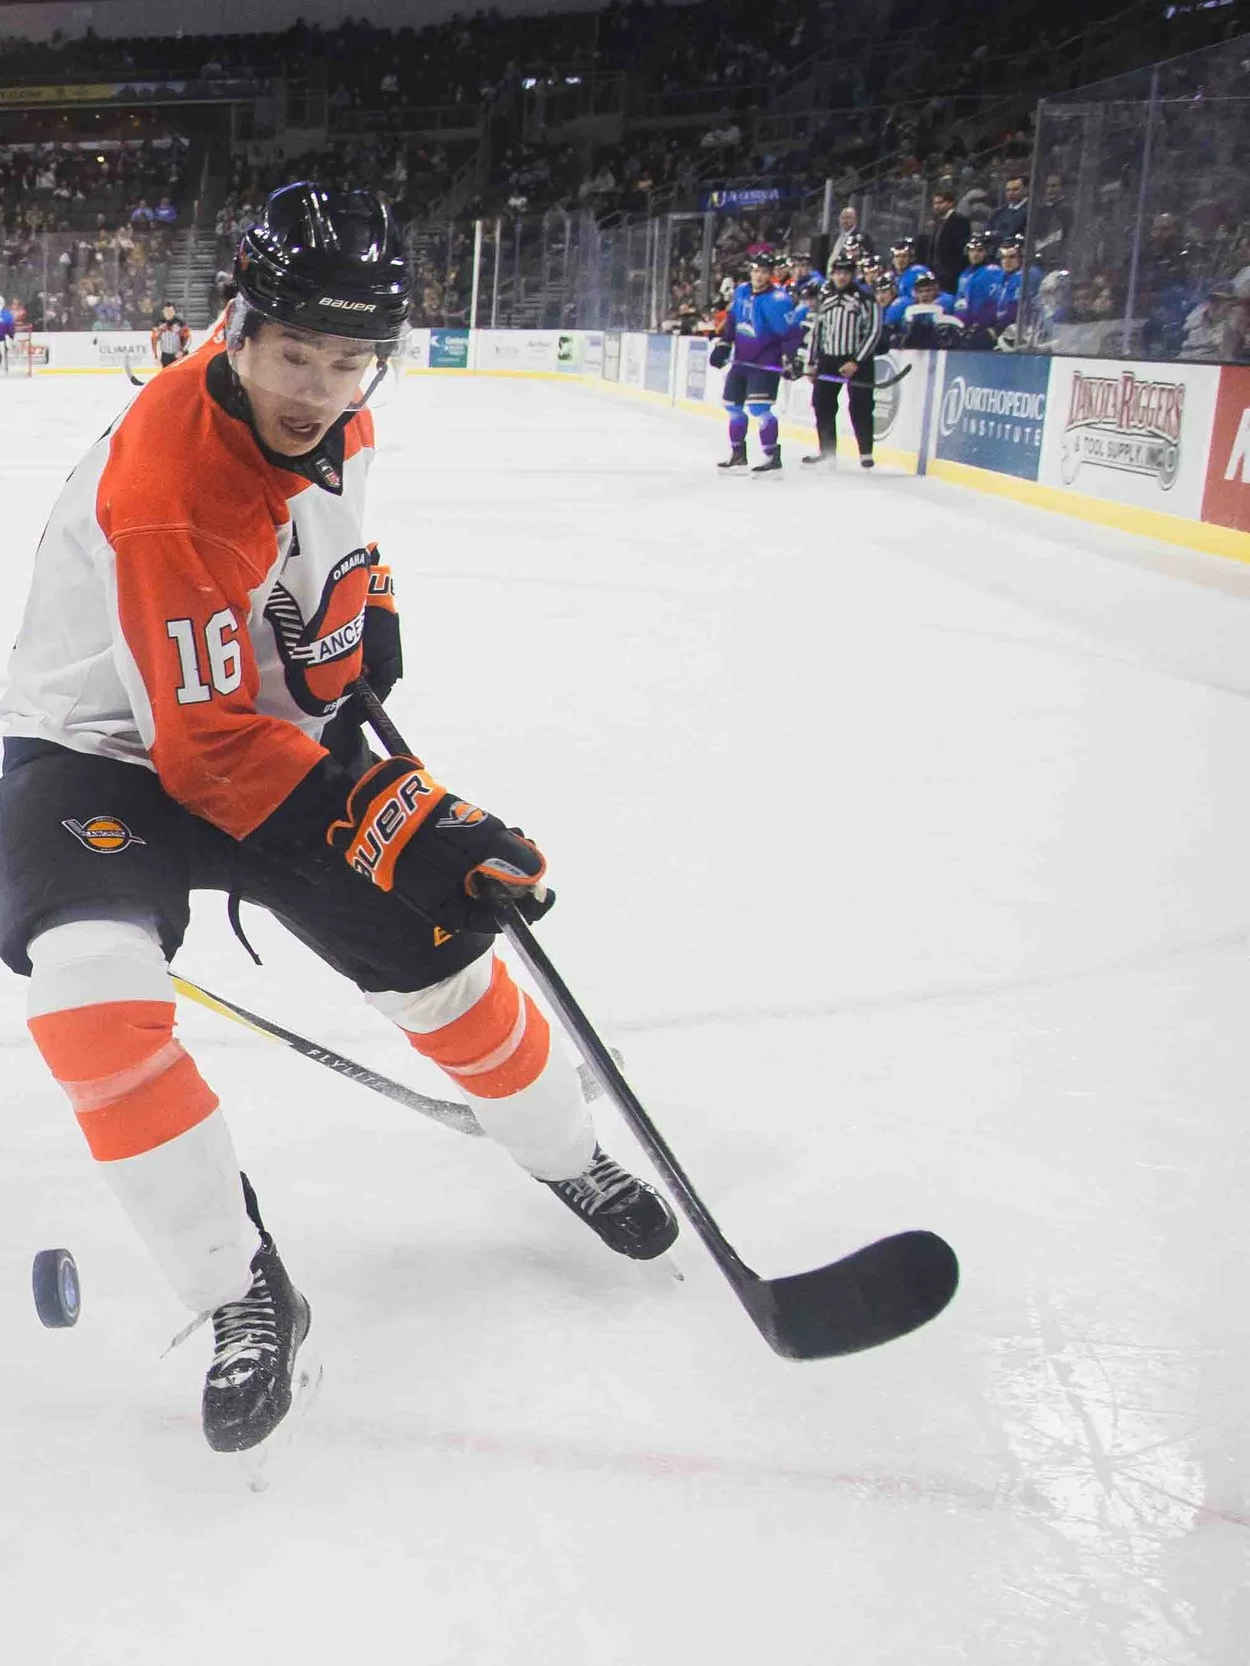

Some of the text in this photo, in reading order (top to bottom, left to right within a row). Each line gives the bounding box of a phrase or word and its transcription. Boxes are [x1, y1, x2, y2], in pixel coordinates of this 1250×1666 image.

[964, 386, 1045, 420] ORTHOPEDIC
[961, 417, 1042, 446] INSTITUTE
[333, 552, 366, 581] OMAHA
[165, 606, 242, 705] 16
